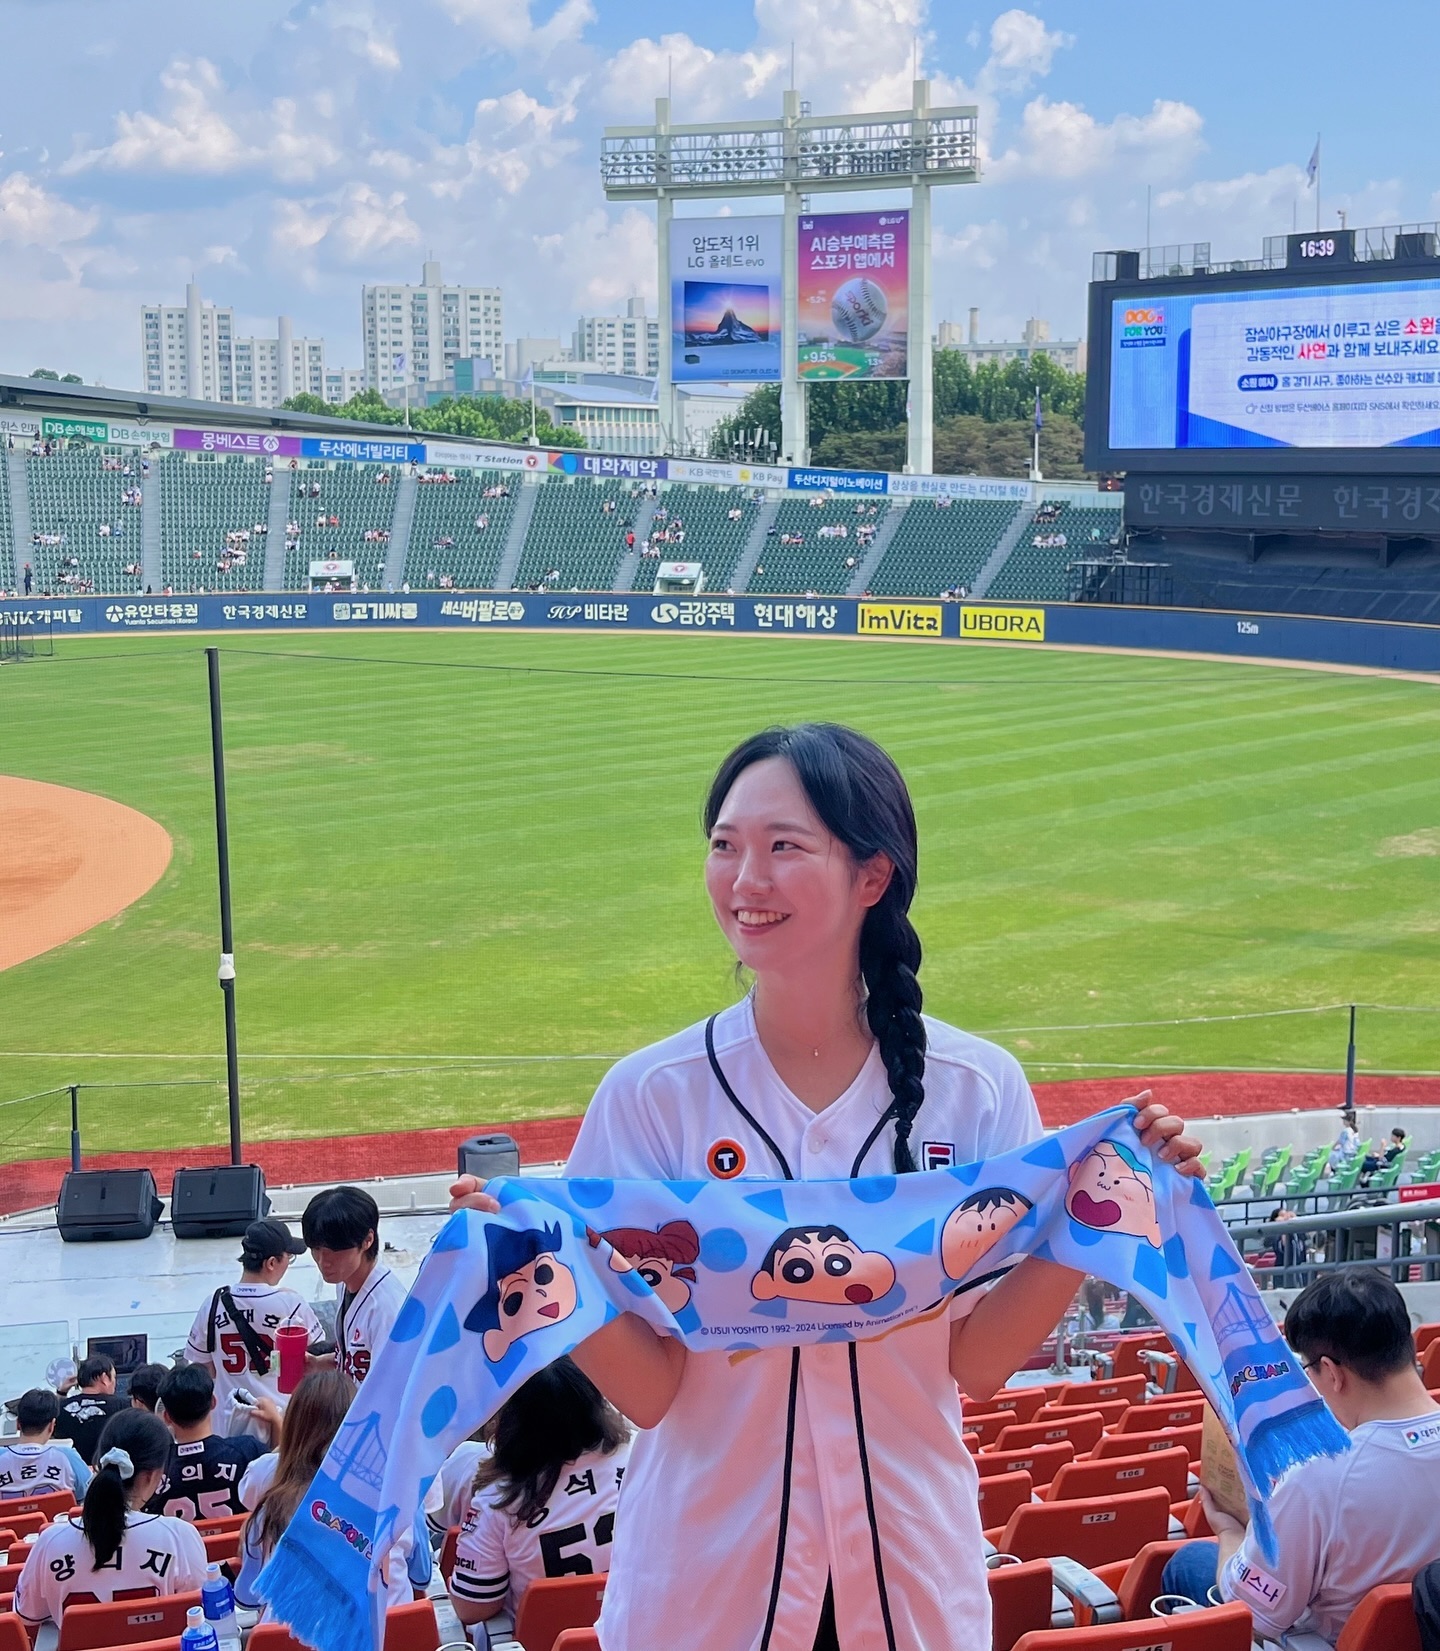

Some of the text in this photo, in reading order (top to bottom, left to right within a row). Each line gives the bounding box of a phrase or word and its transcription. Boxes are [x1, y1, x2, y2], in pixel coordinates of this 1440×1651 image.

[692, 234, 759, 253] 압도적 1위
[810, 233, 895, 252] AI승부예측은
[1300, 239, 1335, 258] 16:39
[687, 256, 704, 268] LG
[810, 252, 895, 270] 스포키 앱에서
[1144, 325, 1163, 336] YOU
[1245, 323, 1330, 343] 잠실야구장에서
[1333, 322, 1371, 338] 이루고
[1374, 320, 1400, 337] 싶은
[1246, 339, 1439, 362] 감동적인 사연과 함께 보내주세요
[1293, 376, 1311, 388] 경기
[1375, 372, 1403, 385] 선수와
[201, 432, 261, 450] 몽베스트
[318, 441, 408, 460] 두산에너빌리티
[484, 454, 523, 465] Station
[583, 457, 658, 478] 대화제약
[752, 470, 783, 484] KB Pay
[794, 474, 883, 490] 두산디지털이노베이션
[892, 480, 918, 492] 상상을
[921, 480, 947, 494] 현실로
[950, 482, 977, 495] 만드는
[980, 483, 1007, 496] 디지털
[1139, 483, 1303, 518] 한국경제신문
[0, 611, 35, 626] NK
[124, 603, 198, 618] 유안타증권
[222, 604, 308, 620] 한국경제신문
[440, 599, 508, 622] 세신버팔로
[584, 604, 630, 621] 비타란
[679, 602, 735, 625] 금강주택
[753, 603, 838, 629] 현대해상
[963, 613, 1041, 633] UBORA
[1237, 621, 1259, 634] 125m
[710, 1326, 730, 1335] USUI
[731, 1326, 769, 1335] YOSHITO
[771, 1323, 816, 1334] 1992-2024
[817, 1320, 853, 1331] Licensed
[854, 1320, 864, 1329] by
[866, 1312, 904, 1327] Animation
[1122, 1469, 1140, 1478] 106
[311, 1500, 370, 1553] CRAYON
[1089, 1513, 1110, 1523] 122
[135, 1614, 156, 1623] 111
